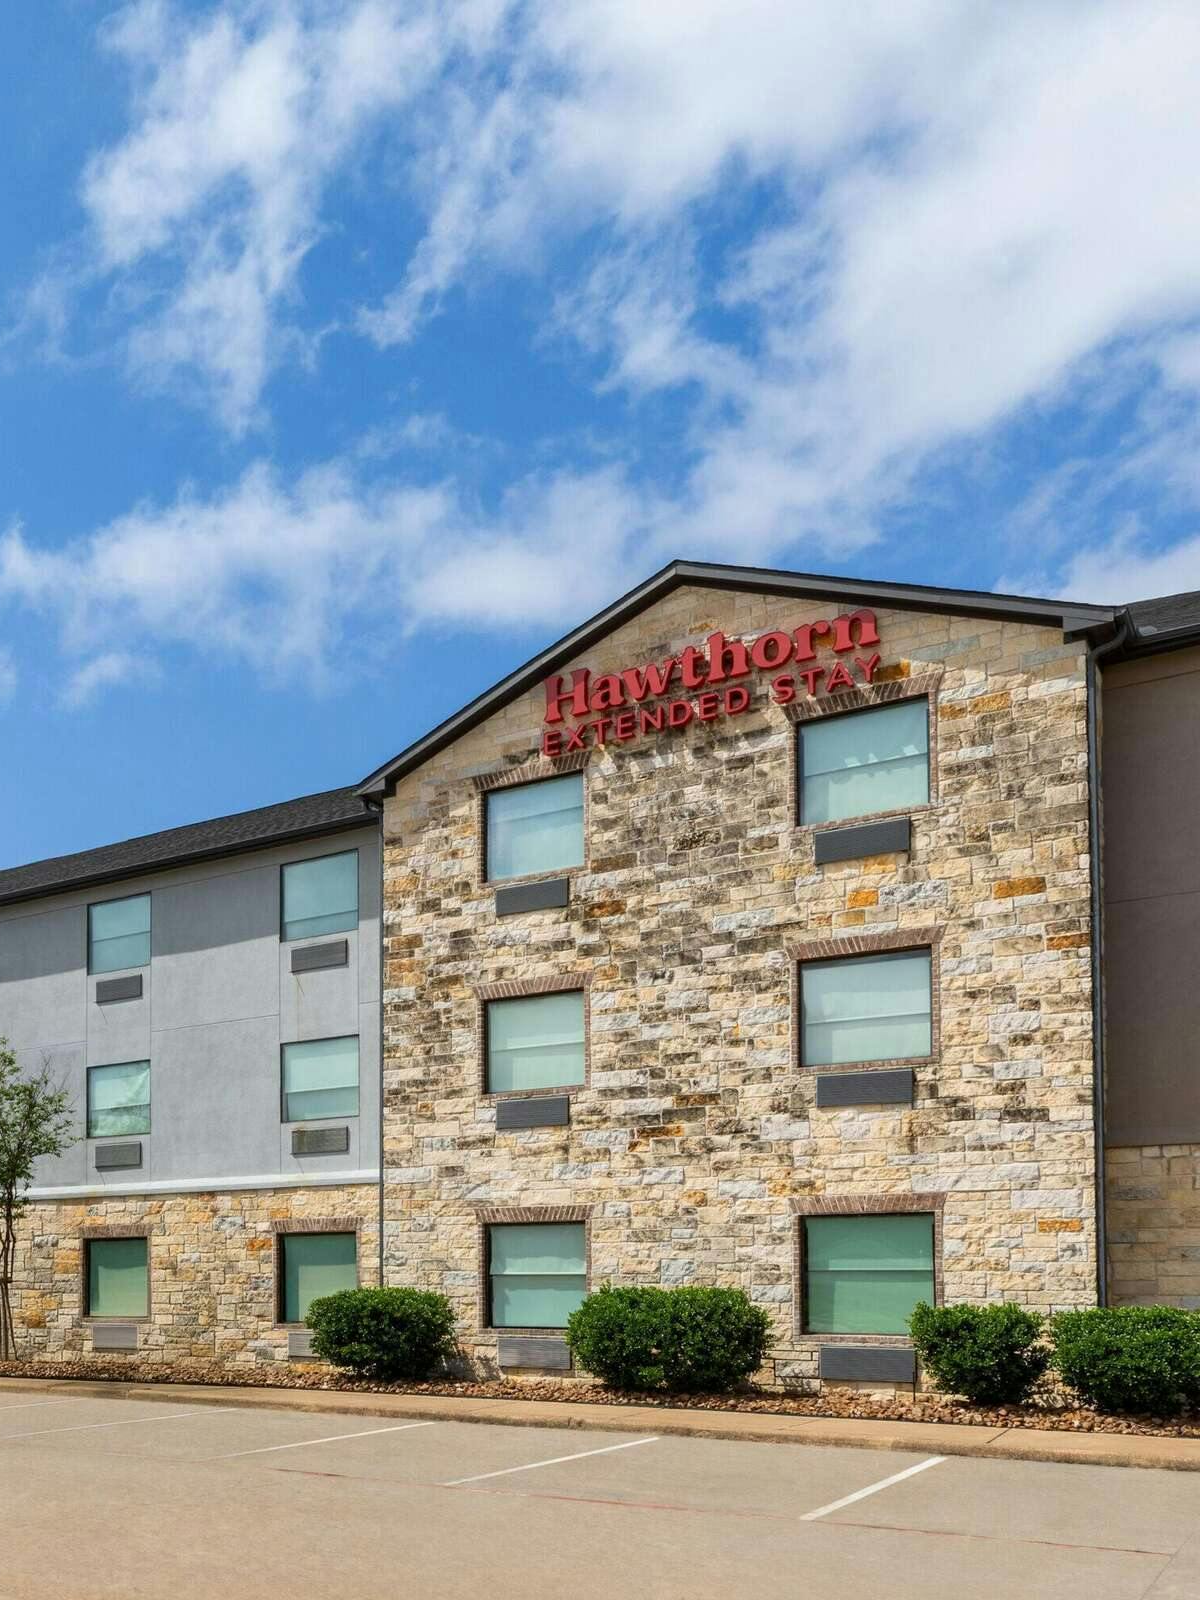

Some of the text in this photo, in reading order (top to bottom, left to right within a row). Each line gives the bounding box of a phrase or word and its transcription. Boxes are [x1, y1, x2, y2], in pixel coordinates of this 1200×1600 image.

[542, 653, 881, 757] EXTENDED STAY
[543, 608, 881, 724] Hawthorn
